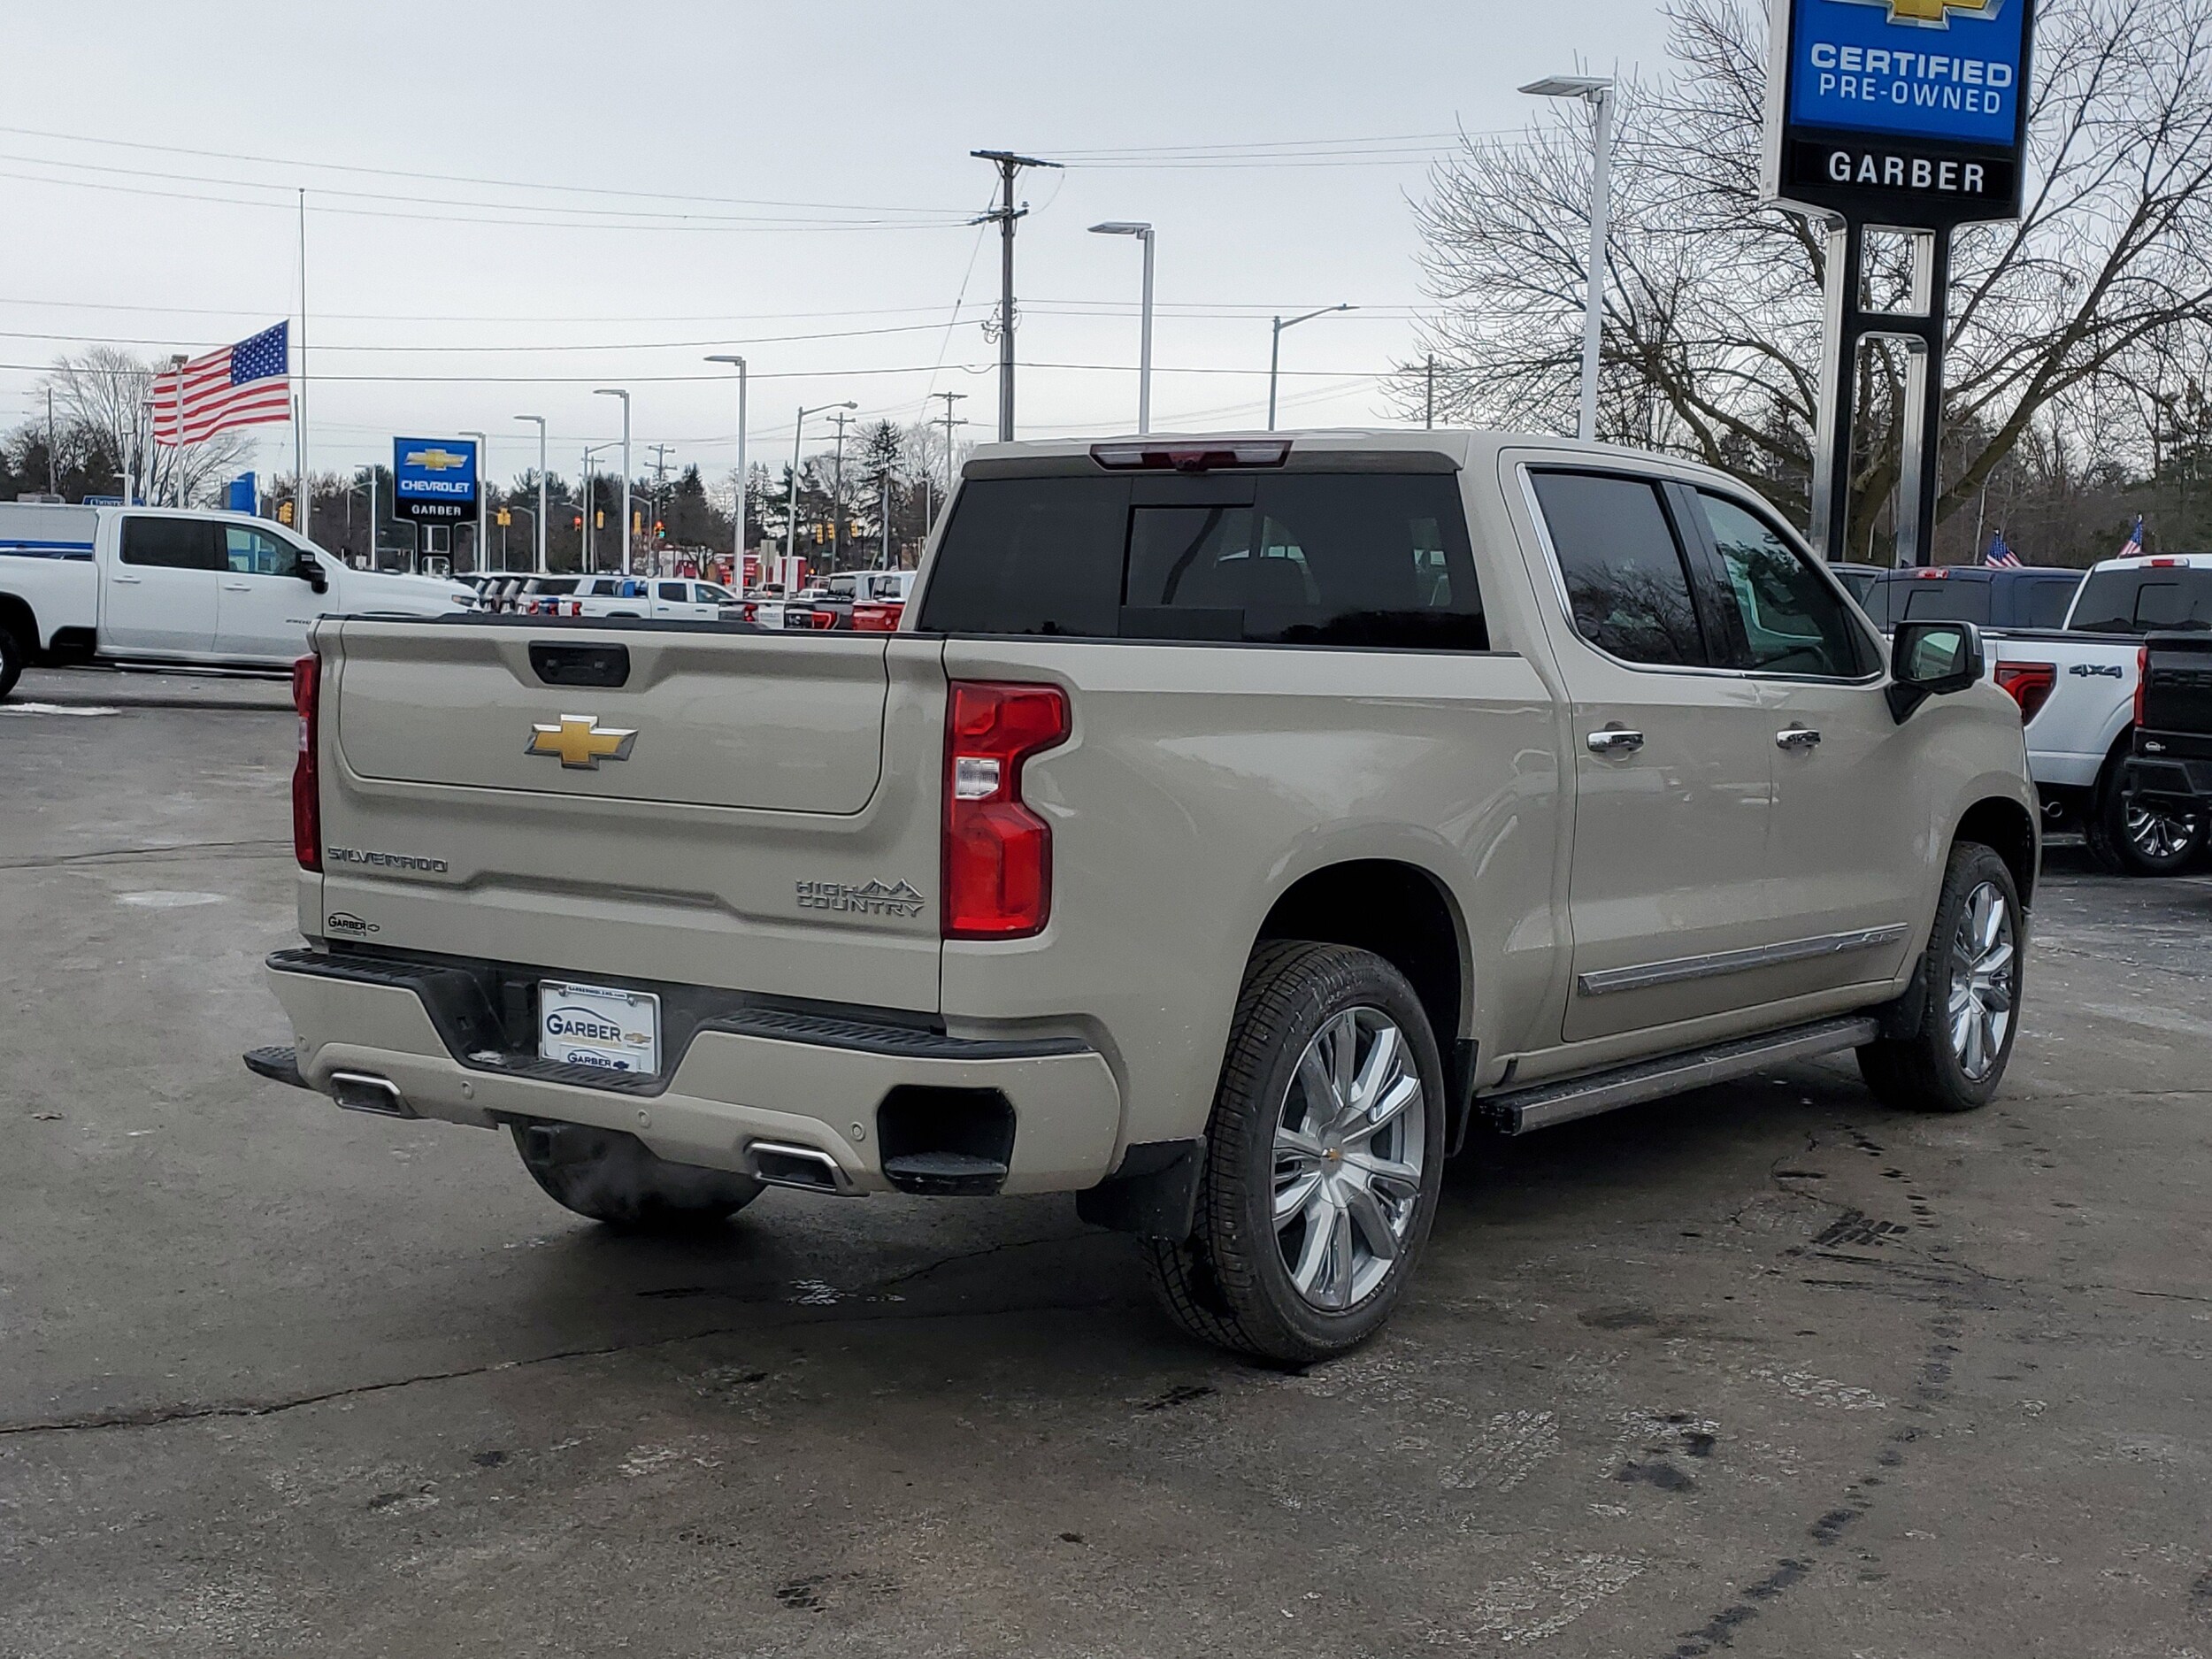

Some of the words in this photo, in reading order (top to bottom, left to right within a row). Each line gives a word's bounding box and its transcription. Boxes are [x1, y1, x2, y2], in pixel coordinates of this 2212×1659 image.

[1811, 42, 2012, 88] CERTIFIED
[1819, 73, 2001, 114] PRE-OWNED
[1829, 151, 1984, 193] GARBER
[401, 480, 470, 493] CHEVROLET
[411, 504, 462, 516] GARBER
[327, 846, 449, 872] SILVERADO
[795, 879, 859, 897] HIGH
[796, 894, 925, 918] COUNTRY
[327, 915, 367, 931] GARBER
[546, 1013, 622, 1042] GARBER
[567, 1052, 611, 1067] GARBER
